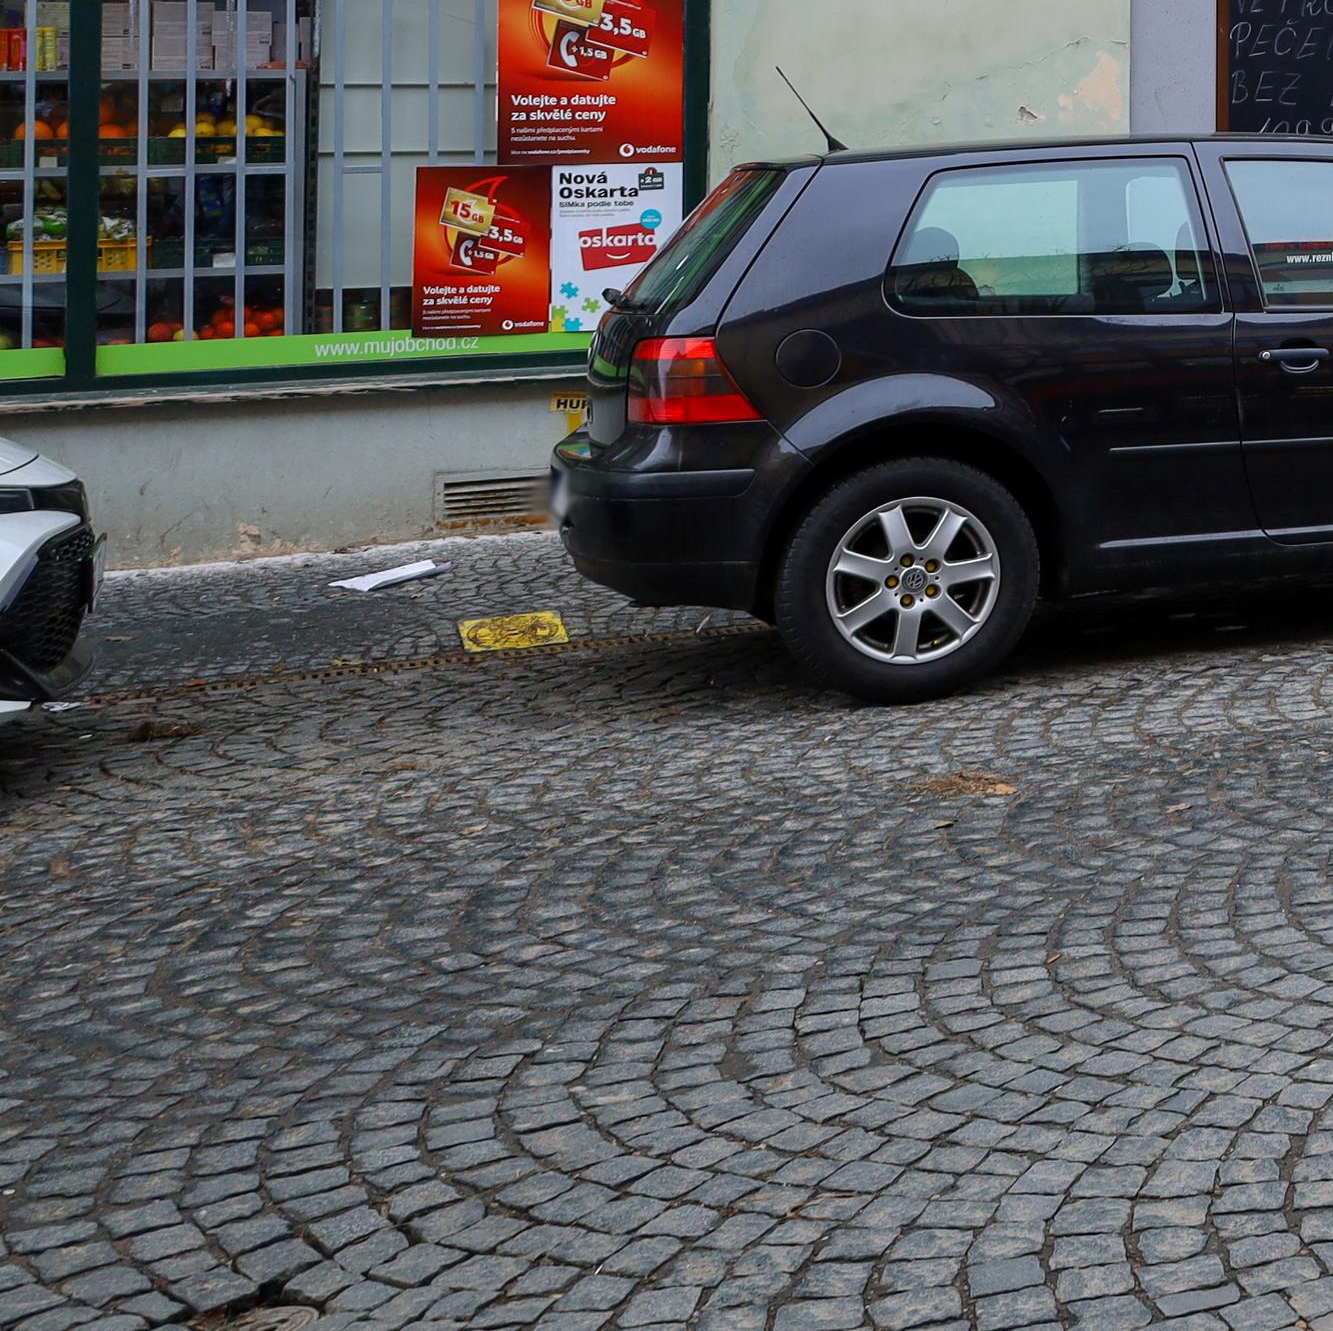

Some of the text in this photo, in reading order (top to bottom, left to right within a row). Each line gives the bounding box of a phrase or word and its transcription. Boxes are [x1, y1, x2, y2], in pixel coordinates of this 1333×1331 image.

[600, 13, 646, 39] 3,5 GB
[1231, 69, 1303, 106] BEZ
[511, 94, 616, 108] Volejte a datujte
[511, 109, 607, 122] za skvělé ceny
[636, 145, 677, 154] vodafone
[559, 171, 608, 184] Nová
[559, 186, 639, 199] Oskarta
[450, 200, 471, 219] 15
[587, 200, 612, 208] podle
[489, 226, 513, 242] 3,5
[579, 227, 656, 248] oskarta
[423, 286, 457, 295] Volejte
[467, 285, 501, 295] datujte
[436, 296, 468, 305] skvělé
[470, 297, 493, 306] ceny
